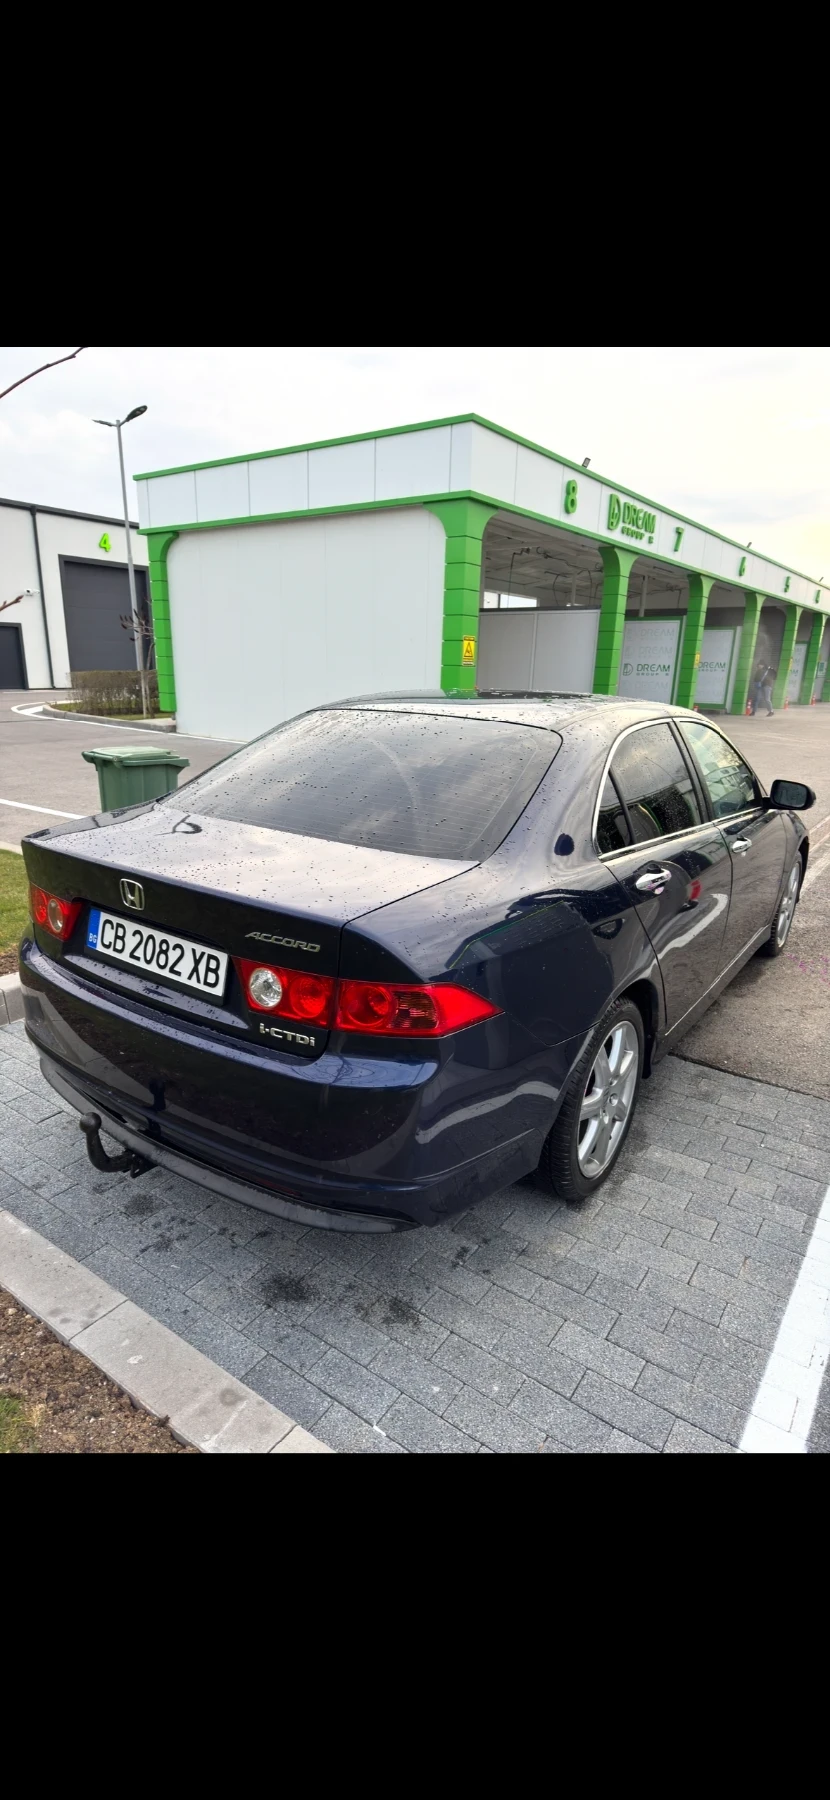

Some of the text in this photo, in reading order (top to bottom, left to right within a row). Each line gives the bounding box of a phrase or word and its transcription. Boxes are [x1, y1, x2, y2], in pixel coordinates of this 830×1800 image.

[564, 479, 578, 514] 8
[622, 501, 656, 534] DREAM
[98, 532, 112, 552] 4
[673, 526, 685, 552] 7
[738, 556, 747, 577] 6
[636, 663, 670, 672] DREAM
[88, 933, 97, 944] BG
[244, 931, 321, 953] ACCORD
[100, 919, 221, 989] CB 2082 XB
